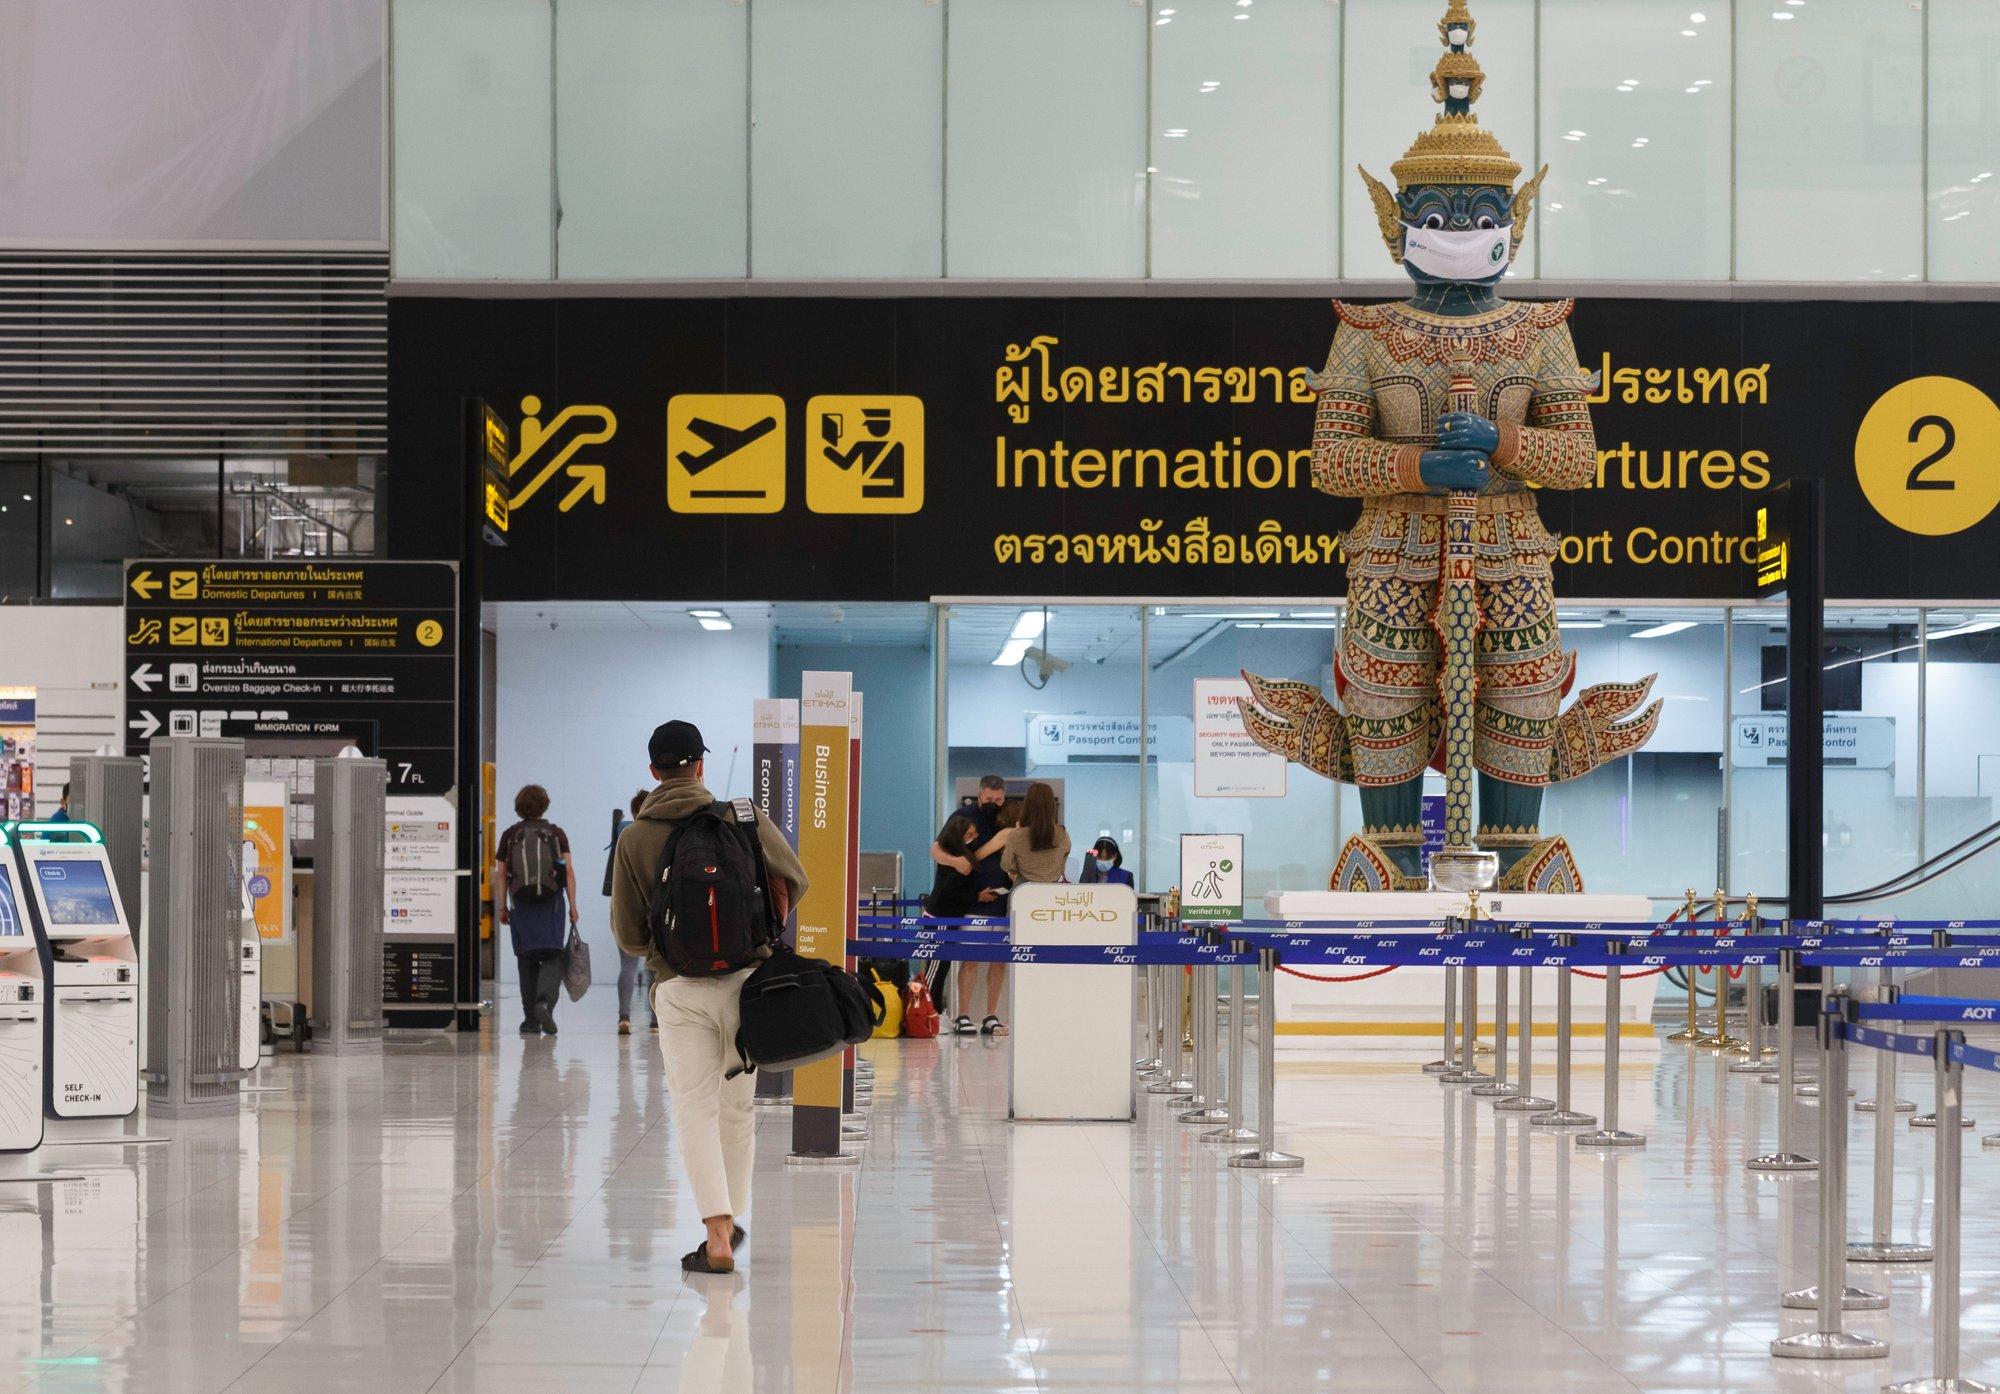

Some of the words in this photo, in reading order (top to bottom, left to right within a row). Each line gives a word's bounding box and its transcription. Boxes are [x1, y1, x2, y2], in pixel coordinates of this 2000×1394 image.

[1906, 415, 1955, 490] 2
[1583, 442, 1770, 489] rtures
[1550, 531, 1613, 565] ort
[202, 564, 364, 585] ผู้โดยสารขาออกภายในประเทศ
[202, 590, 248, 600] Domestic
[251, 590, 305, 601] Departures
[424, 626, 433, 640] 2
[235, 637, 291, 647] International
[293, 637, 343, 648] Departures
[202, 683, 240, 693] Oversize
[242, 683, 281, 695] Baggage
[283, 683, 321, 693] Check-in
[803, 700, 847, 708] ETIHAD
[254, 723, 310, 731] IMMIGRATION
[314, 724, 340, 732] FORM
[1068, 721, 1157, 732] ตรวจหนังสือเดินาง
[1068, 735, 1115, 747] Passport
[1768, 738, 1788, 747] Pas
[1823, 738, 1856, 747] ontrol
[398, 762, 412, 783] 7
[815, 745, 830, 829] Business
[785, 759, 795, 833] Economy
[1031, 909, 1118, 922] ETIHAD
[1222, 908, 1232, 916] Fly
[1429, 920, 1446, 928] AOT
[1806, 920, 1824, 928] AOT
[799, 925, 828, 933] Platinum
[799, 935, 814, 943] Gold
[915, 932, 937, 940] AOT
[1290, 938, 1311, 946] AOT
[1377, 940, 1398, 948] AOT
[1464, 940, 1486, 948] AOT
[1714, 940, 1736, 948] AOT
[1801, 939, 1822, 947] AOT
[1888, 937, 1908, 945] AOT
[912, 950, 936, 958] AOT
[1104, 946, 1126, 954] AOT
[1197, 946, 1220, 954] AOT
[1324, 946, 1348, 955] AOT
[1419, 948, 1442, 956] AOT
[1512, 948, 1534, 956] AOT
[1012, 954, 1036, 962] AOT
[1113, 955, 1136, 963] AOT
[1214, 954, 1238, 962] AOT
[1342, 956, 1367, 964] AOT
[1442, 956, 1467, 965] AOT
[1542, 956, 1566, 965] AOT
[1642, 956, 1666, 964] AOT
[1742, 956, 1766, 964] AOT
[1860, 957, 1884, 966] AOT
[1959, 958, 1983, 966] AOT
[1962, 1008, 1996, 1019] AOT
[64, 1084, 84, 1092] SELF
[64, 1093, 101, 1102] CHECK-IN
